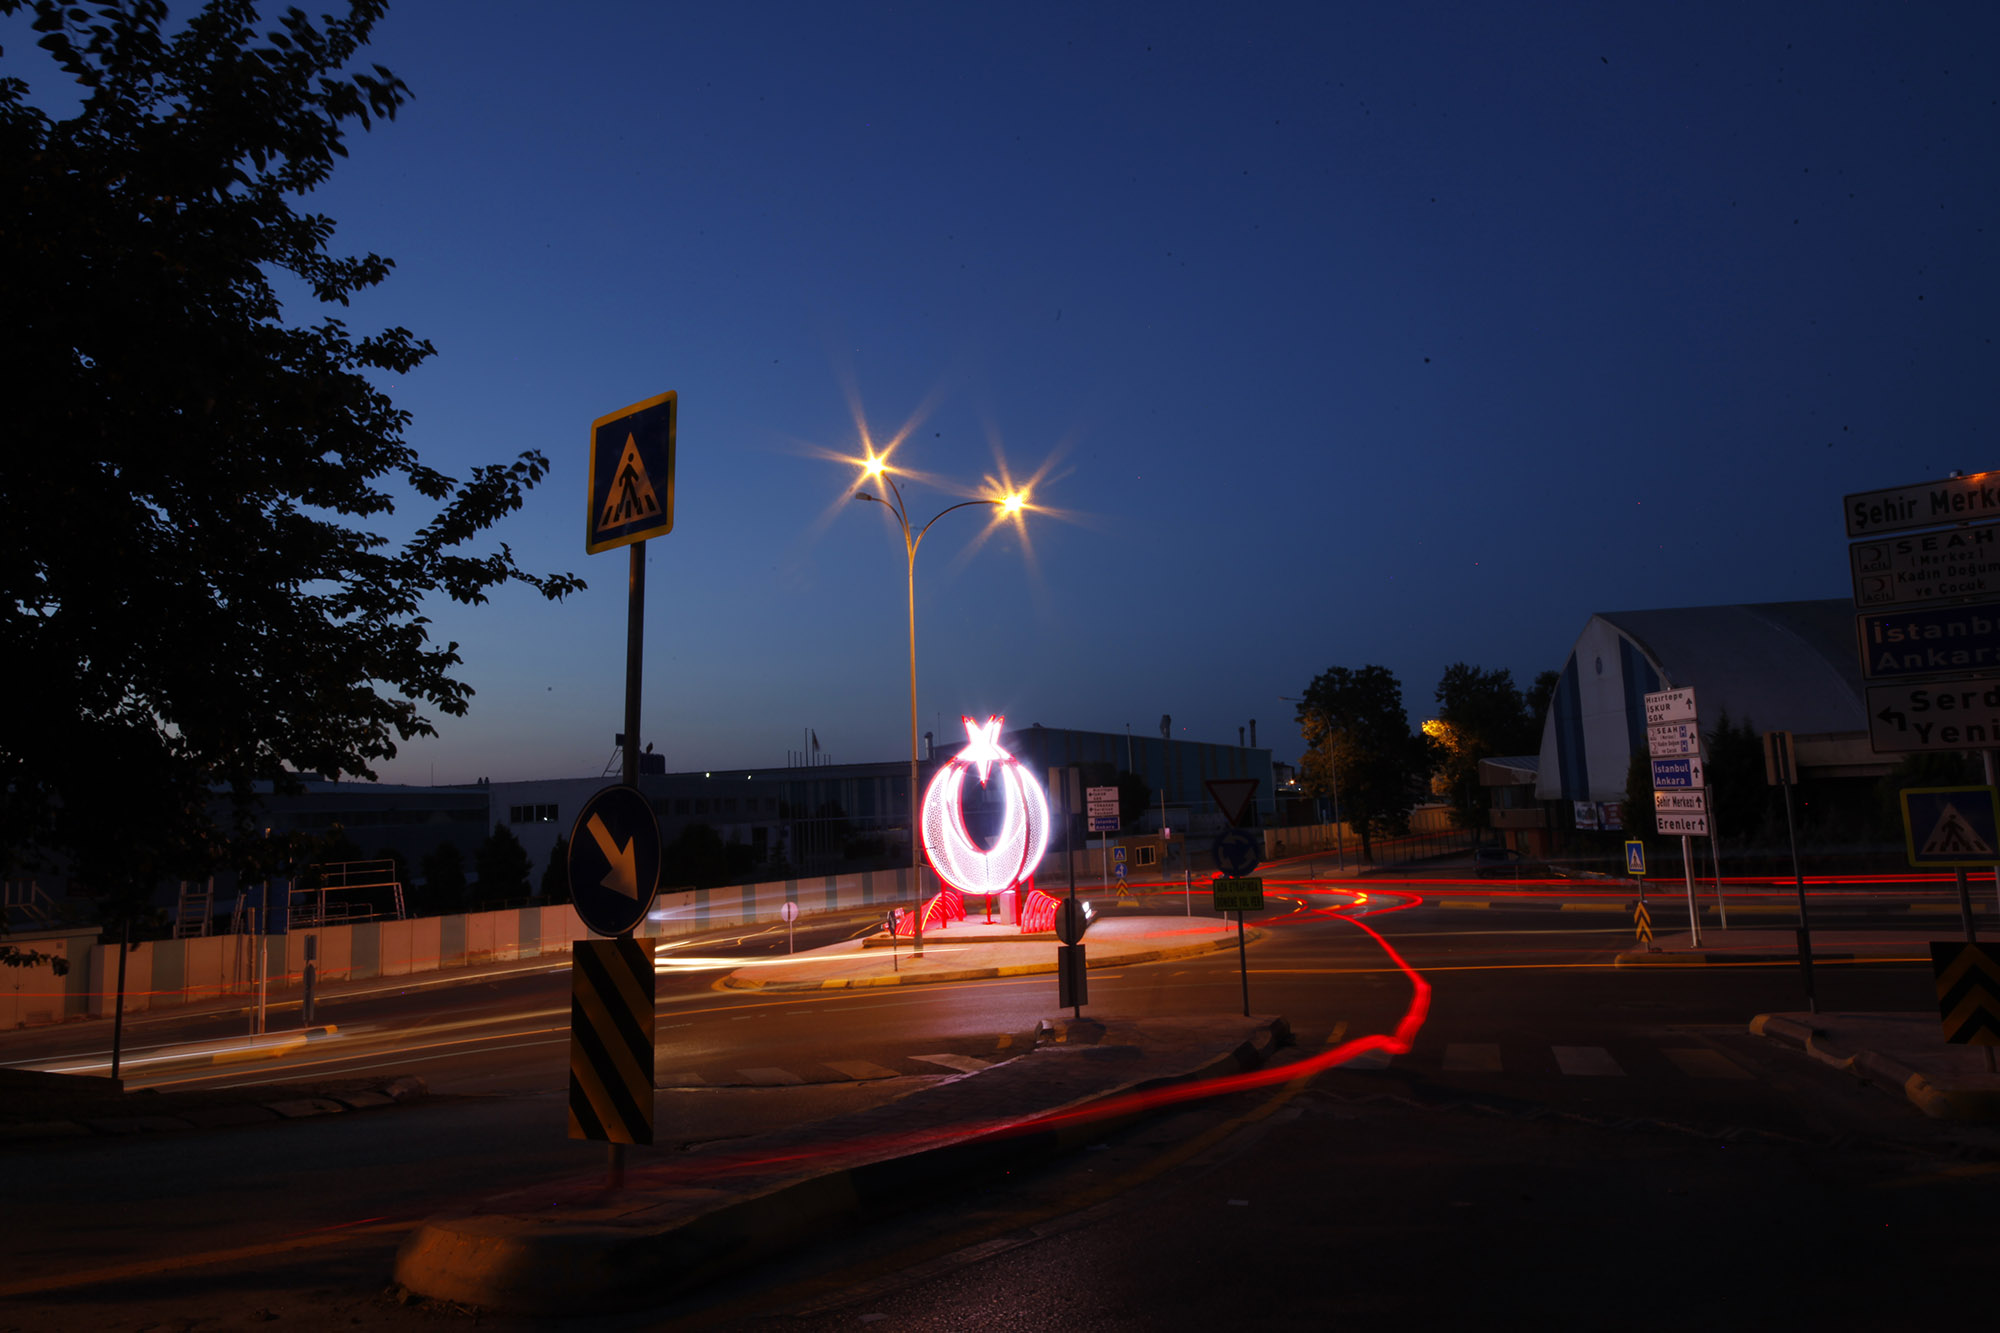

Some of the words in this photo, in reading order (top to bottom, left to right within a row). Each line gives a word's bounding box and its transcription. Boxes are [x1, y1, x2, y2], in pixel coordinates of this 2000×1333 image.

[1854, 496, 1917, 529] Şehir
[1929, 484, 2000, 515] Merk
[1896, 530, 1993, 554] SEAH
[1896, 569, 1941, 583] Kadın
[1915, 587, 1932, 597] ve
[1938, 579, 1986, 595] Çocuk
[1873, 616, 2000, 645] İstanb
[1648, 714, 1664, 722] SGK
[1656, 726, 1679, 734] SEAH
[1912, 718, 2000, 744] Yeni
[1656, 776, 1685, 785] Ankara
[1658, 818, 1696, 830] Erenler
